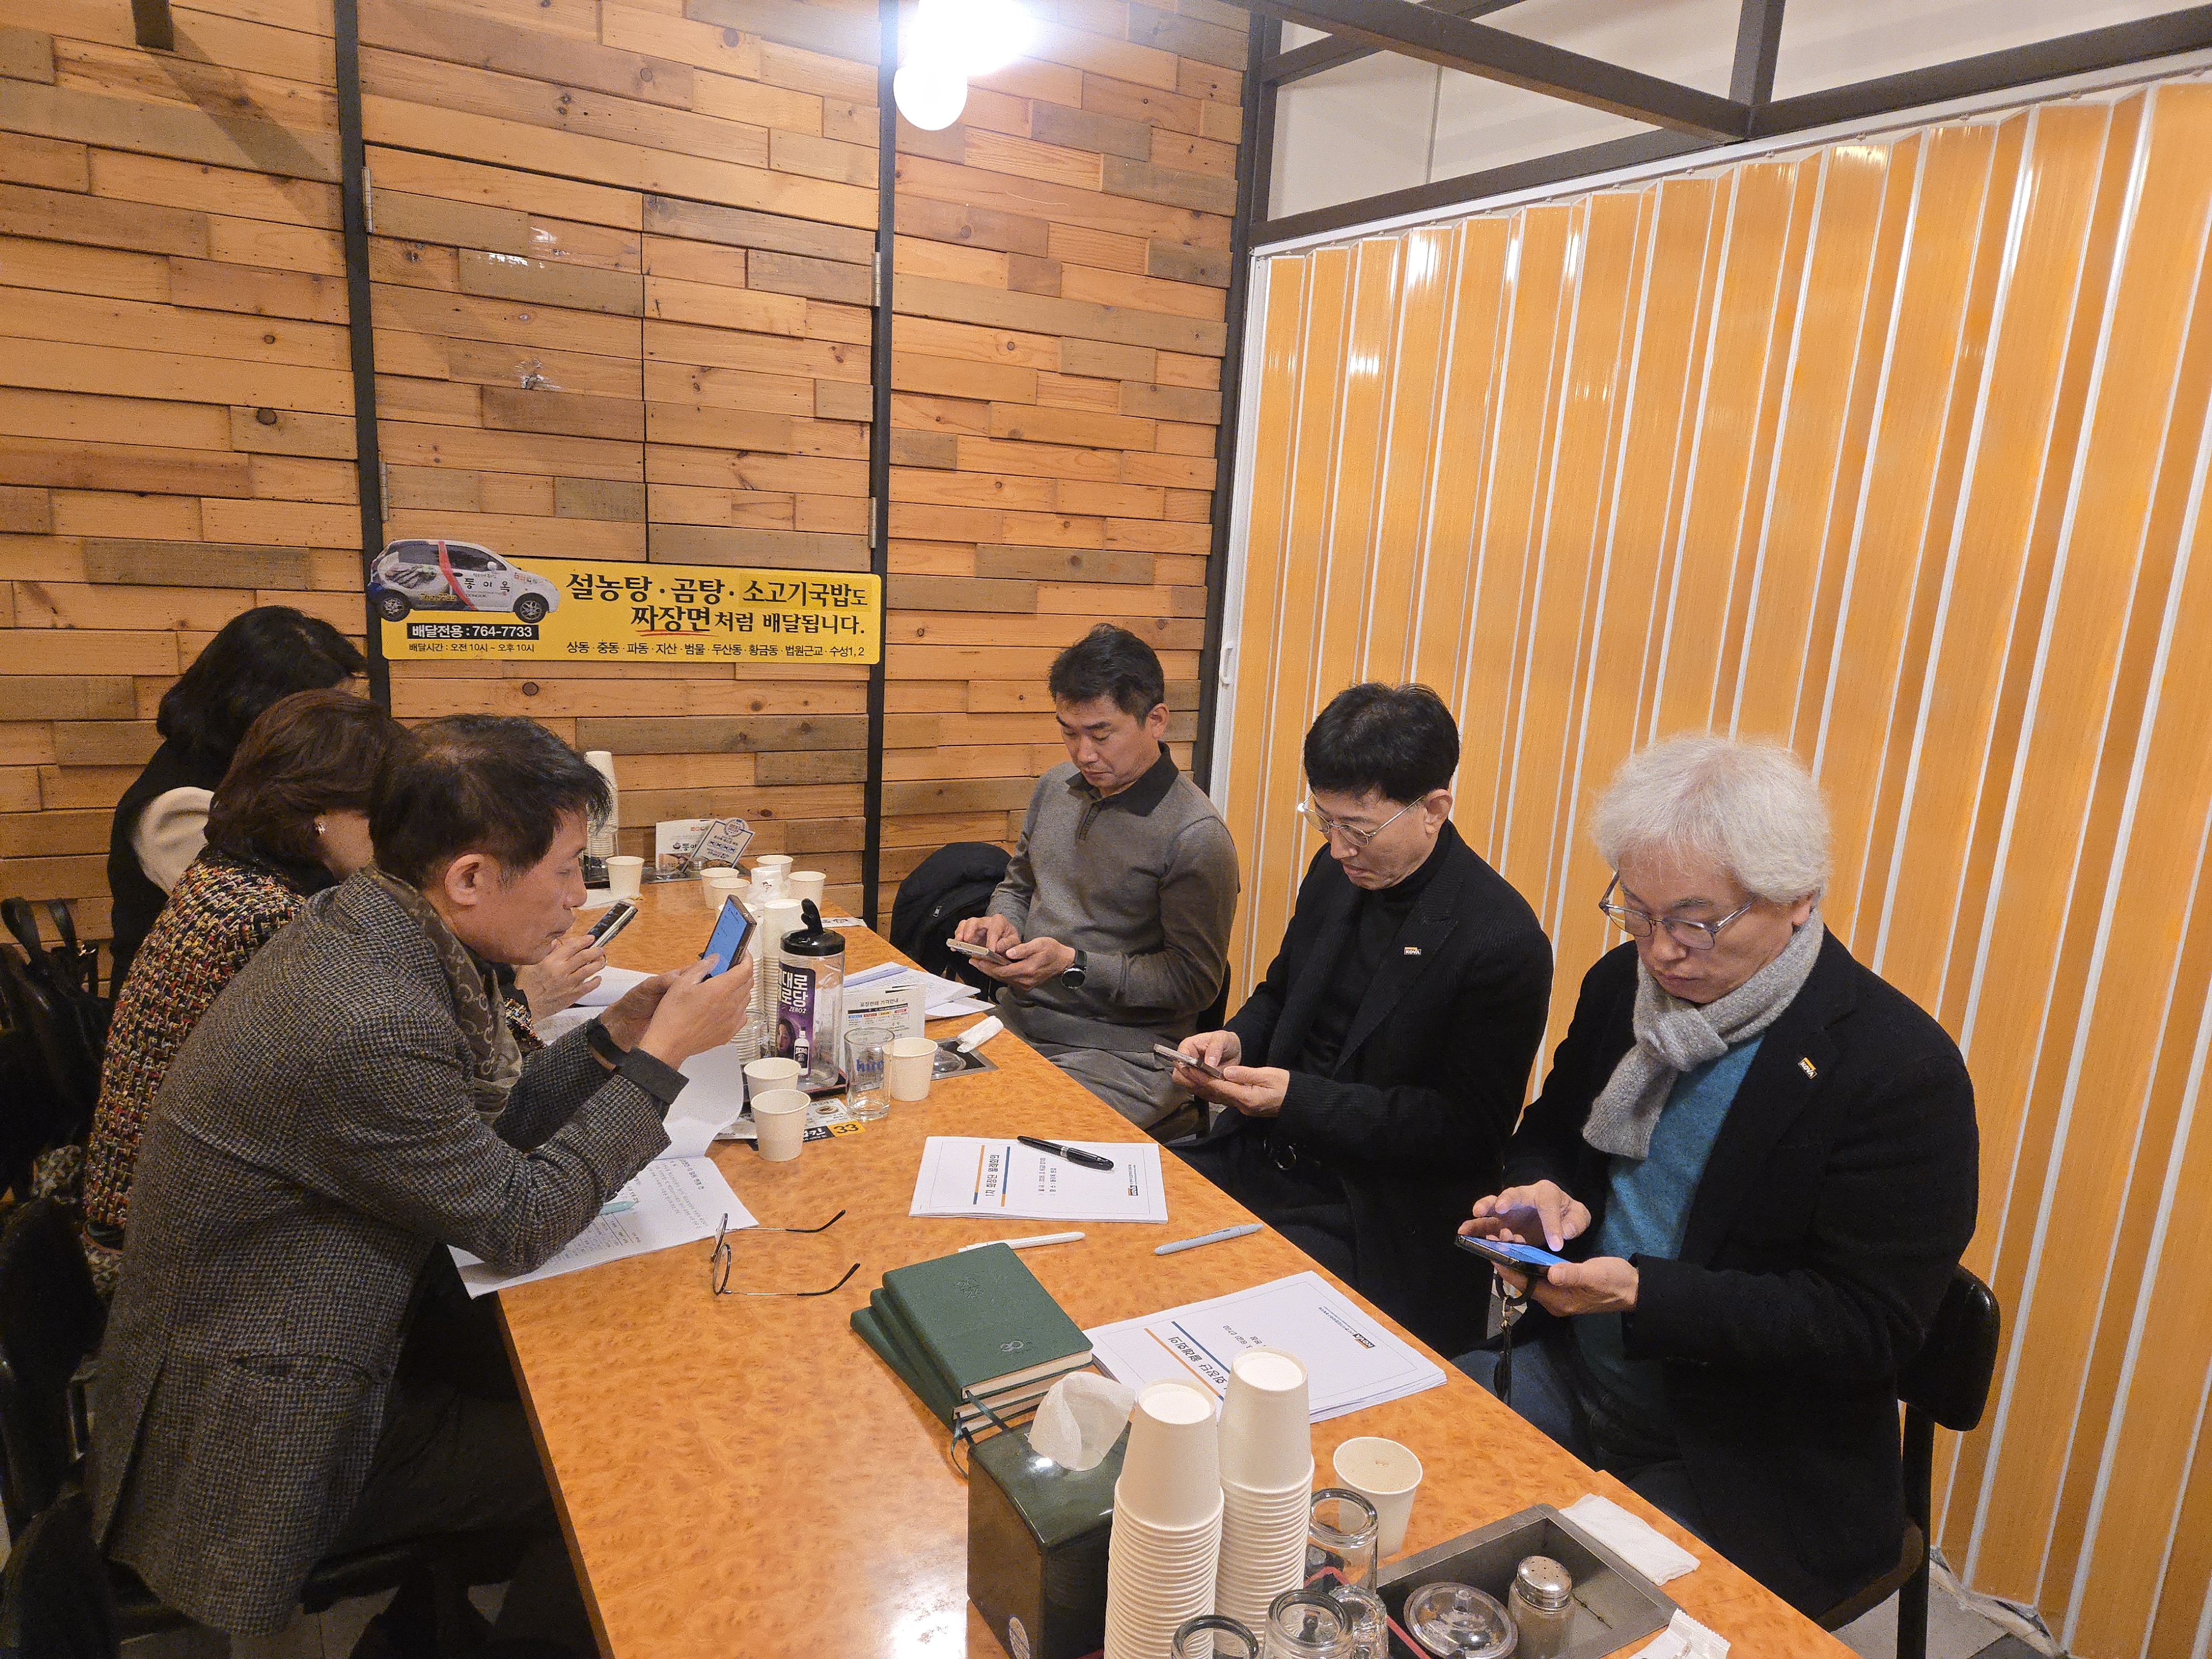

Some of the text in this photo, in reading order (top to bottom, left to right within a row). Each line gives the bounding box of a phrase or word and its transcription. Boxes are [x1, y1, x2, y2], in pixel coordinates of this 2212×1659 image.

[566, 573, 868, 607] 설농탕 곰탕 소고기국밥도
[472, 626, 533, 637] 764-7733
[763, 613, 865, 635] 배달됩니다.
[450, 643, 467, 651] 오전
[469, 643, 488, 652] 10시
[498, 644, 515, 652] 오후
[518, 644, 534, 653] 10시
[566, 641, 589, 653] 상동
[597, 641, 619, 654] 중동
[627, 642, 649, 654] 파동
[655, 643, 676, 655] 지산
[684, 643, 705, 655] 범물
[712, 644, 742, 656] 두산동
[748, 644, 779, 656] 황금동
[785, 645, 823, 656] 법원근교
[1800, 1061, 1814, 1077] KOVA
[833, 1124, 859, 1134] 33
[1355, 1334, 1374, 1349] KOVA
